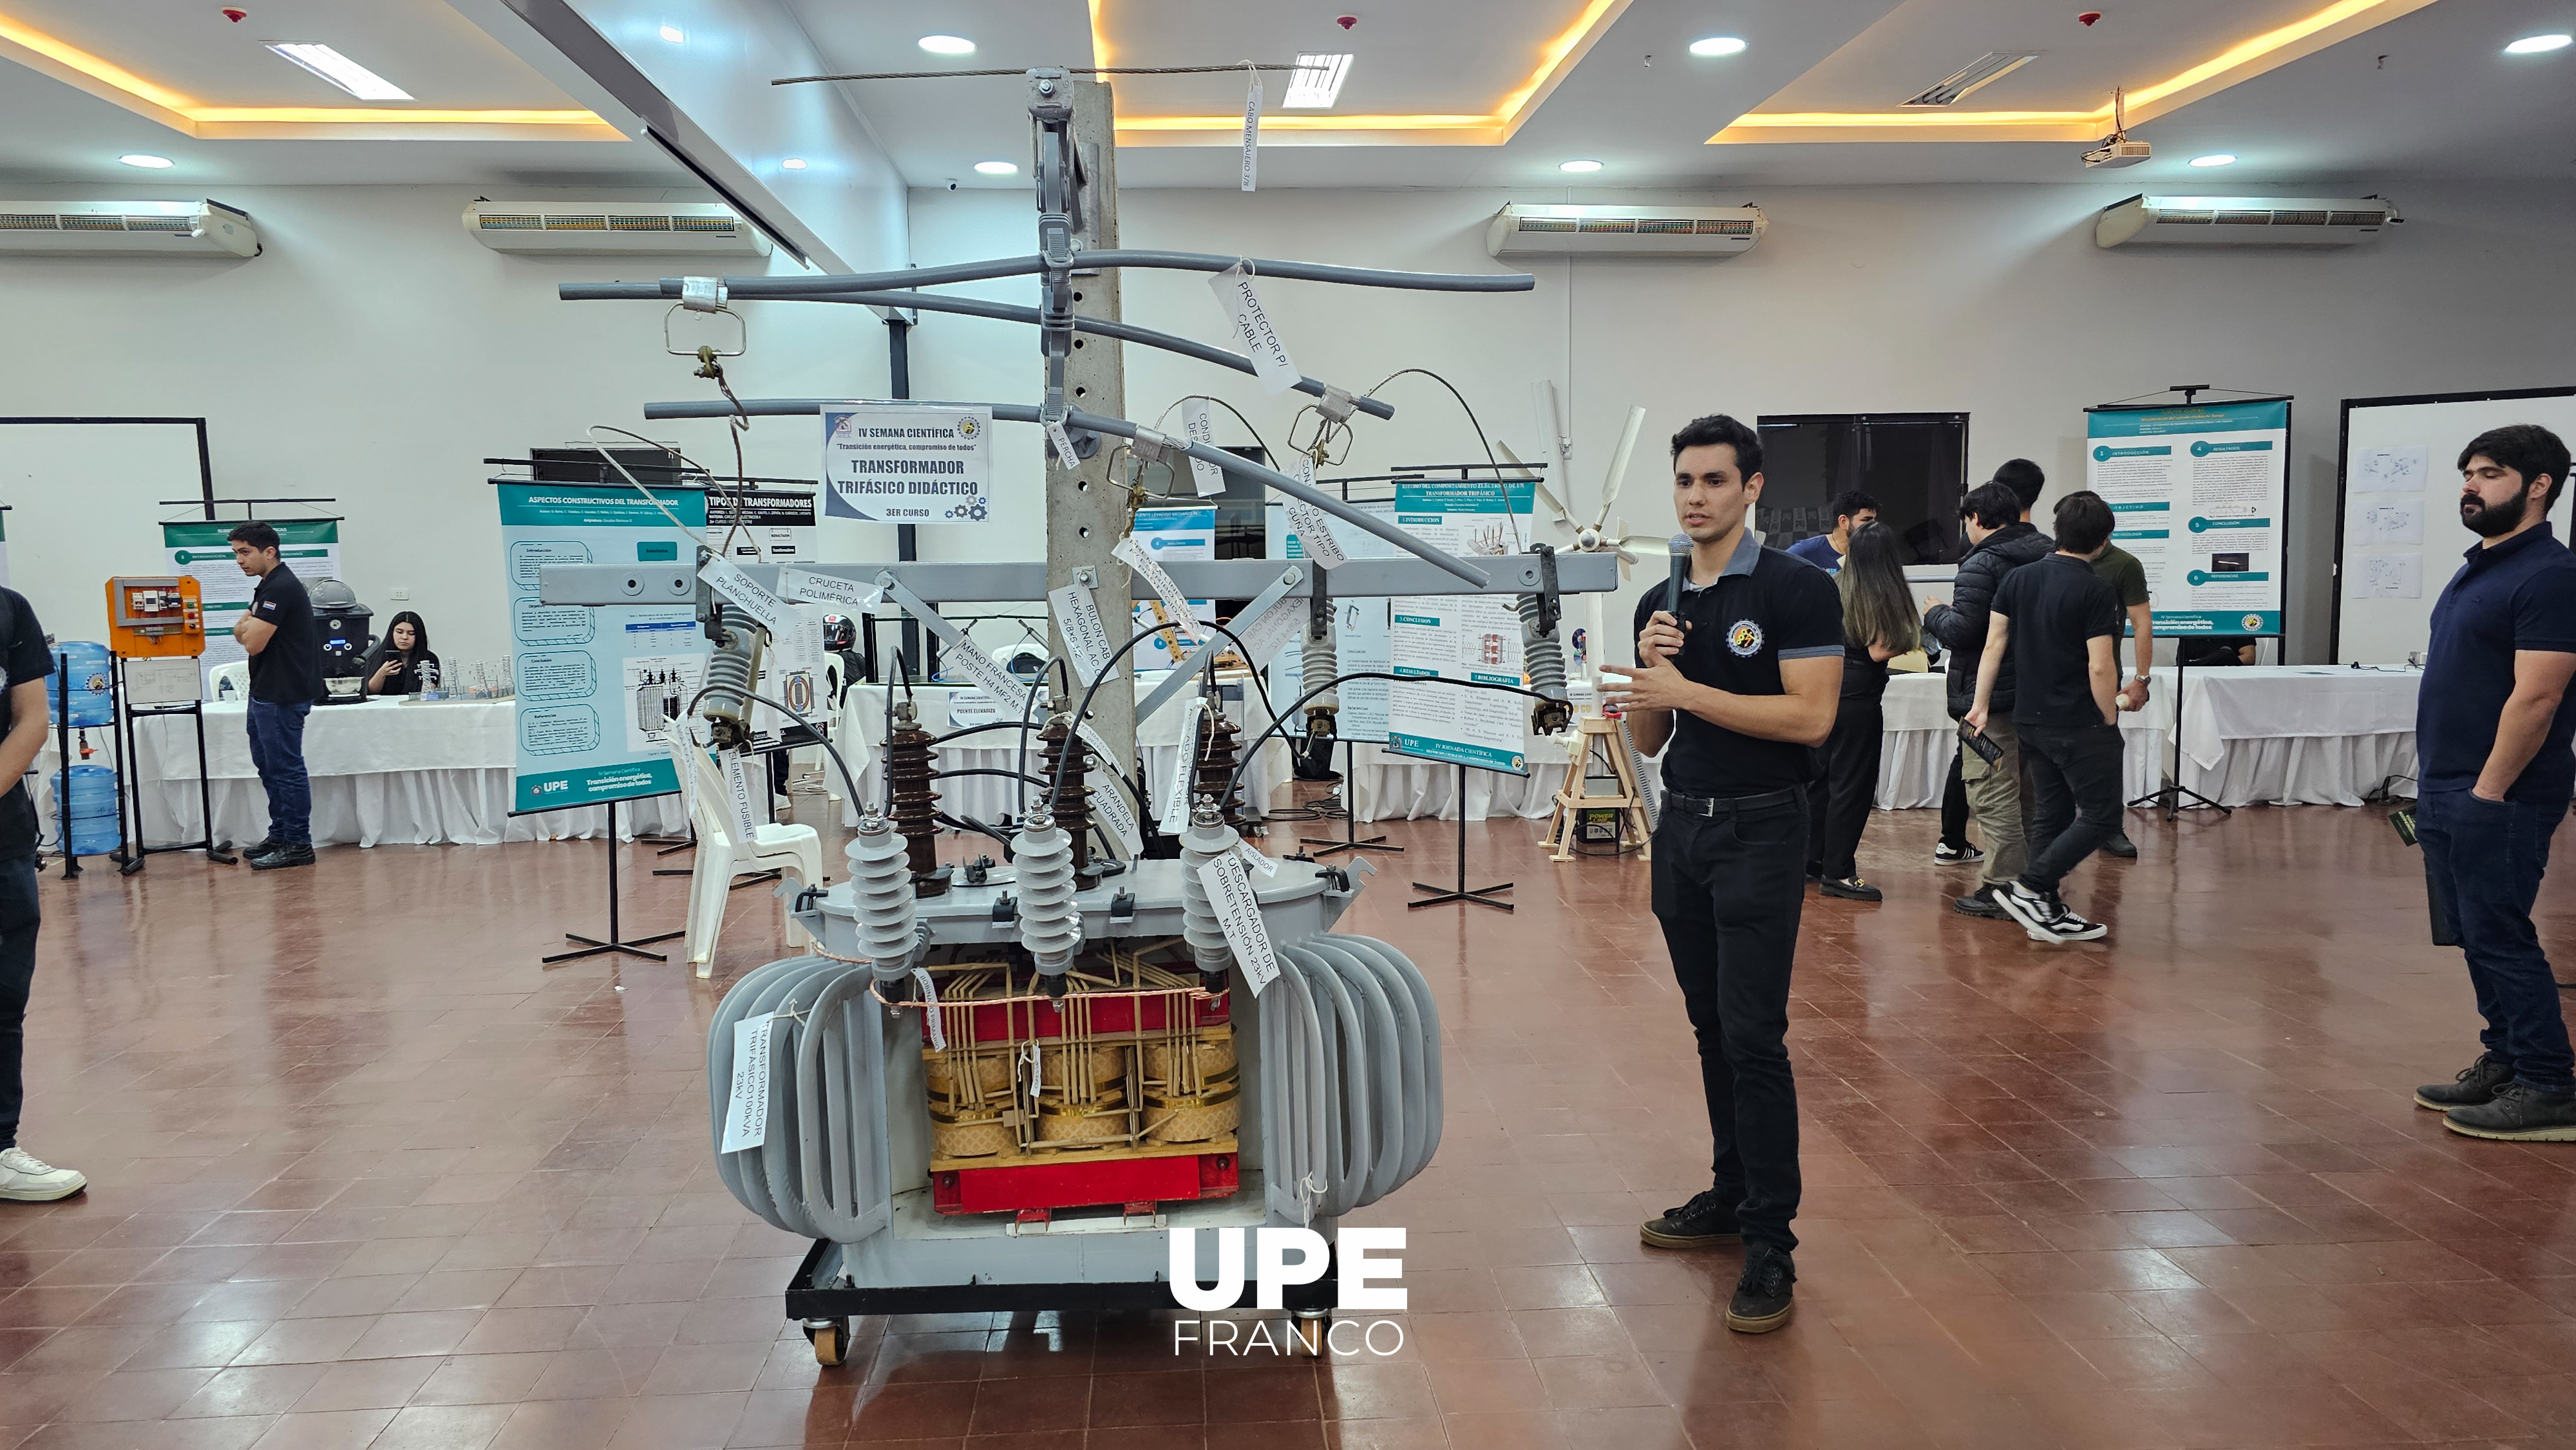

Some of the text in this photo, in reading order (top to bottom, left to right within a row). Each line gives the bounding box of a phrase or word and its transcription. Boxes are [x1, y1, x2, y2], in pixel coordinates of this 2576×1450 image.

[1247, 101, 1255, 123] CABO
[1244, 125, 1252, 171] MENSAJERO
[1238, 282, 1281, 355] PROTECTOR
[1238, 314, 1262, 353] CABLE
[858, 426, 954, 438] IV SEMANA CIENTÍFICA
[851, 460, 964, 475] TRANSFORMADOR
[1059, 437, 1075, 467] PERCHA
[743, 497, 812, 507] TRANSFORMADORES
[838, 479, 978, 495] TRIFÁSICO DIDÁCTICO
[903, 509, 929, 517] CURSO
[1314, 534, 1330, 556] TIPO
[1316, 518, 1345, 561] ESTRIBO
[1129, 539, 1162, 576] PRENSA
[715, 576, 777, 625] PLANCHUELLA
[734, 574, 777, 608] SOPORTE
[800, 588, 858, 607] POLIMÉRICA
[809, 576, 854, 592] CRUCETA
[1138, 565, 1182, 620] PROTEGIDA
[1068, 592, 1100, 667] HEXAGONAL AC
[1086, 604, 1111, 659] BULON CAB
[955, 653, 1026, 716] POSTE H4 MF2 M.T.
[961, 643, 1027, 701] MANO FRANCESA
[1405, 739, 1419, 747] UPE
[1441, 744, 1464, 753] JORNADA
[1464, 748, 1492, 757] CIENTÍFICA
[544, 780, 569, 792] UPE
[586, 773, 652, 786] Transición energética,
[589, 782, 627, 793] compromiso
[634, 778, 652, 787] todos
[728, 751, 755, 838] ELEMENTO FUSIBLE
[1169, 766, 1186, 823] FLEXIBLE
[1093, 790, 1128, 837] CUADRADA
[1102, 784, 1134, 830] ARANDELA
[1245, 847, 1273, 872] AISLADOR
[1213, 858, 1267, 984] SOBRETENSIÓN 23kV
[1222, 918, 1236, 943] M.T.
[1227, 857, 1275, 973] DESCARGADOR DE
[930, 1013, 940, 1050] PRIMARIO
[735, 1072, 744, 1099] 23kV
[753, 1022, 770, 1137] TRANSFORMADOR
